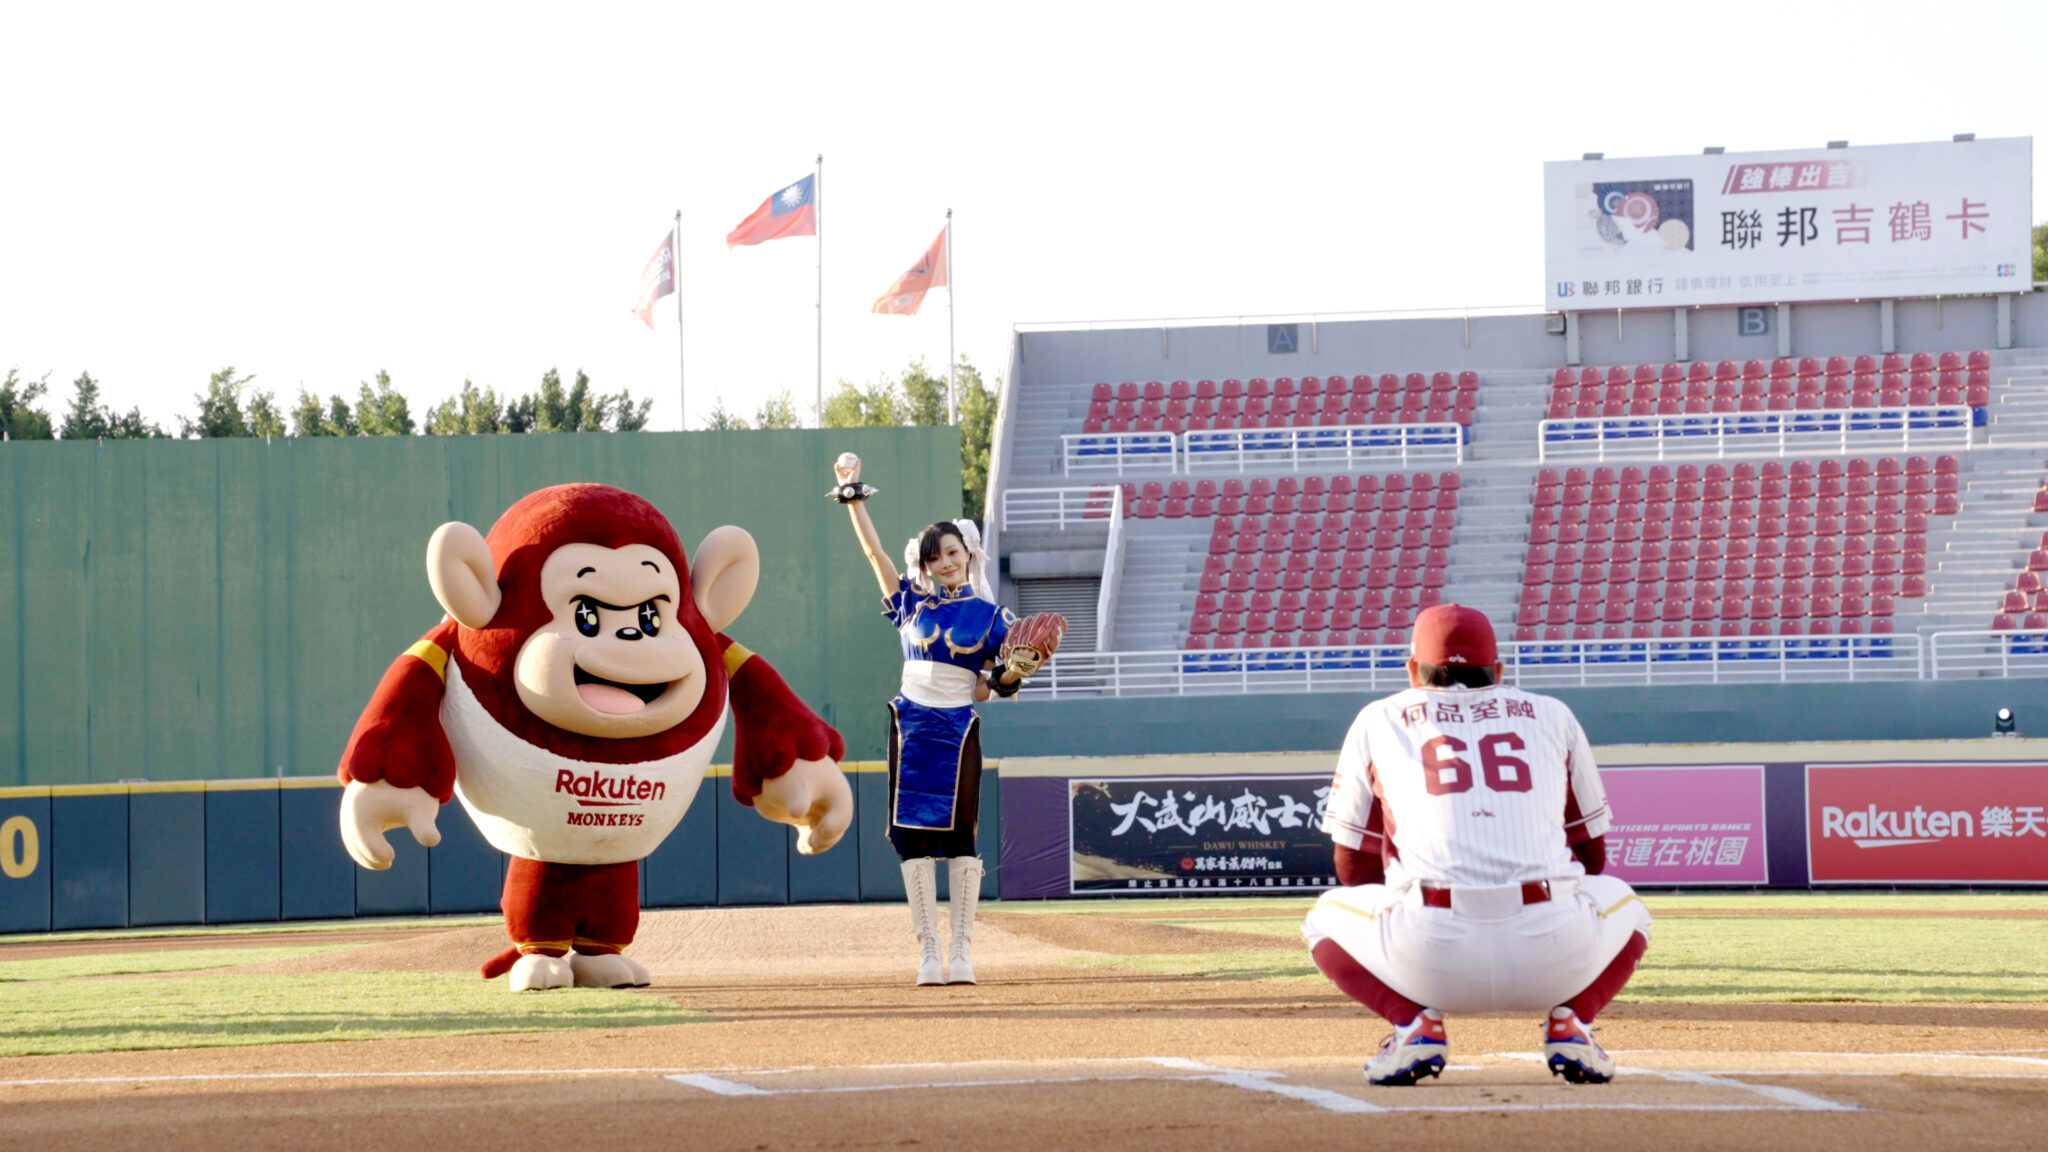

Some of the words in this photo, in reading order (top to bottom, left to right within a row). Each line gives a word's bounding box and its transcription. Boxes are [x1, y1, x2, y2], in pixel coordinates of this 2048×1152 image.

[1721, 197, 1990, 250] 聯邦吉鶴卡
[1582, 278, 1664, 296] 聯邦銀行
[1743, 308, 1765, 334] B
[1271, 326, 1295, 351] A
[1401, 698, 1536, 728] 何品室融
[1421, 732, 1533, 796] 66
[555, 769, 666, 801] Rakuten
[567, 812, 645, 826] MONKEYS
[1662, 823, 1709, 832] SPORTS
[1711, 823, 1752, 831] GAMES
[1822, 804, 1974, 838] Rakuten
[1981, 806, 2047, 838] 樂天
[1203, 841, 1235, 851] DAWU
[1238, 840, 1287, 850] WHISKEY
